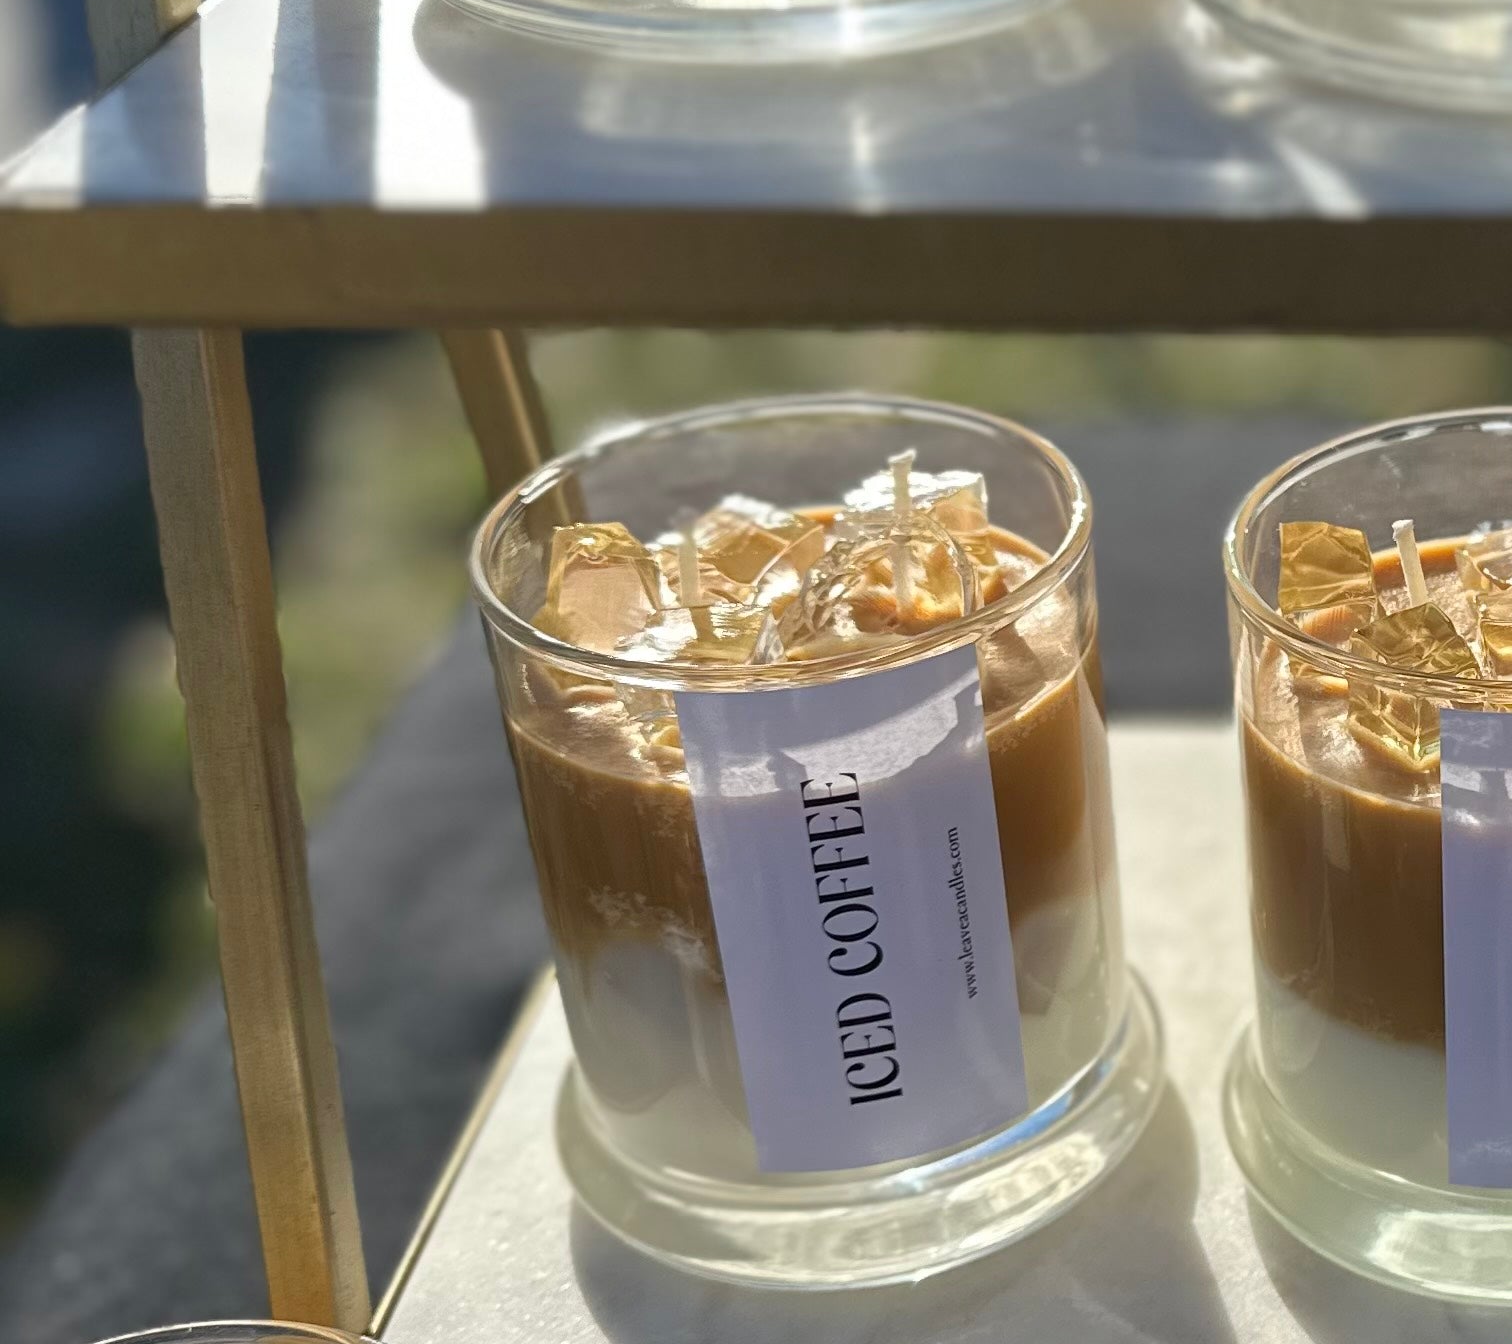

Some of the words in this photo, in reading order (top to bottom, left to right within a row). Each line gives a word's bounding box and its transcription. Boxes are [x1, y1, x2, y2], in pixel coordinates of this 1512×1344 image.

[800, 772, 883, 977] COFFEE
[948, 826, 978, 1000] www.leaveacandles.com
[836, 992, 903, 1106] ICED
